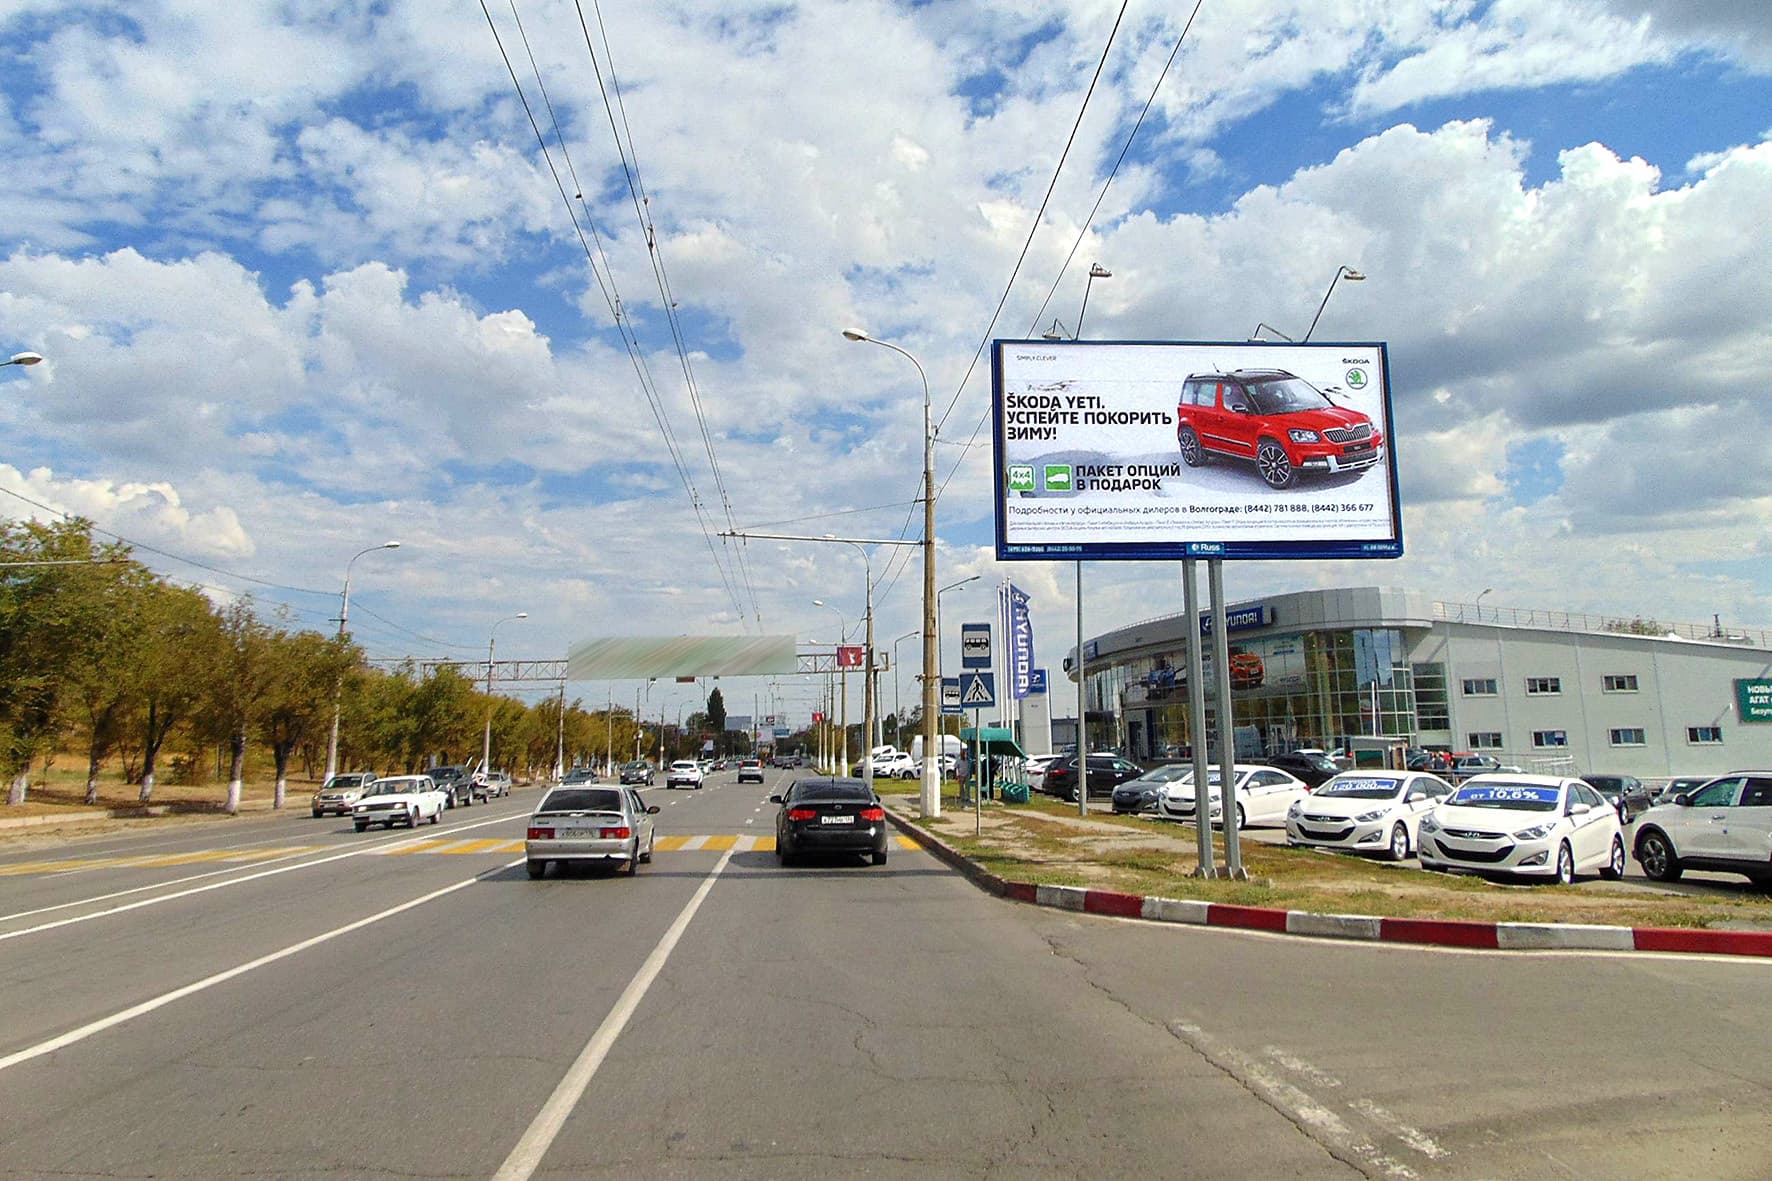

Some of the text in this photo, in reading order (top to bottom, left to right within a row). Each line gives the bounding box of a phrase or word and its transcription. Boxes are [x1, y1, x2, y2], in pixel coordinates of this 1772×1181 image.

[1006, 392, 1105, 409] ŠKODA YETI.
[1007, 409, 1172, 425] УСПЕЙТЕ ПОКОРИТЬ
[1007, 427, 1057, 440] ЗИМУ!
[1076, 463, 1180, 478] ПАКЕТ ОПЦИЙ
[1076, 479, 1161, 492] В ПОДАРОК
[1009, 506, 1068, 515] Подробности
[1070, 507, 1076, 515] у
[1078, 506, 1140, 515] официальных
[1142, 506, 1180, 515] дилеров
[1189, 505, 1242, 514] Волгограде:
[1244, 504, 1272, 514] (8442)
[1274, 504, 1288, 512] 781
[1311, 504, 1339, 513] (8442)
[1341, 504, 1357, 512] 366
[1359, 504, 1374, 512] 677
[1200, 543, 1221, 551] Russ
[1226, 611, 1258, 627] YUNDAI
[1015, 607, 1029, 694] HYUNDAI
[1749, 695, 1769, 704] АГАТ
